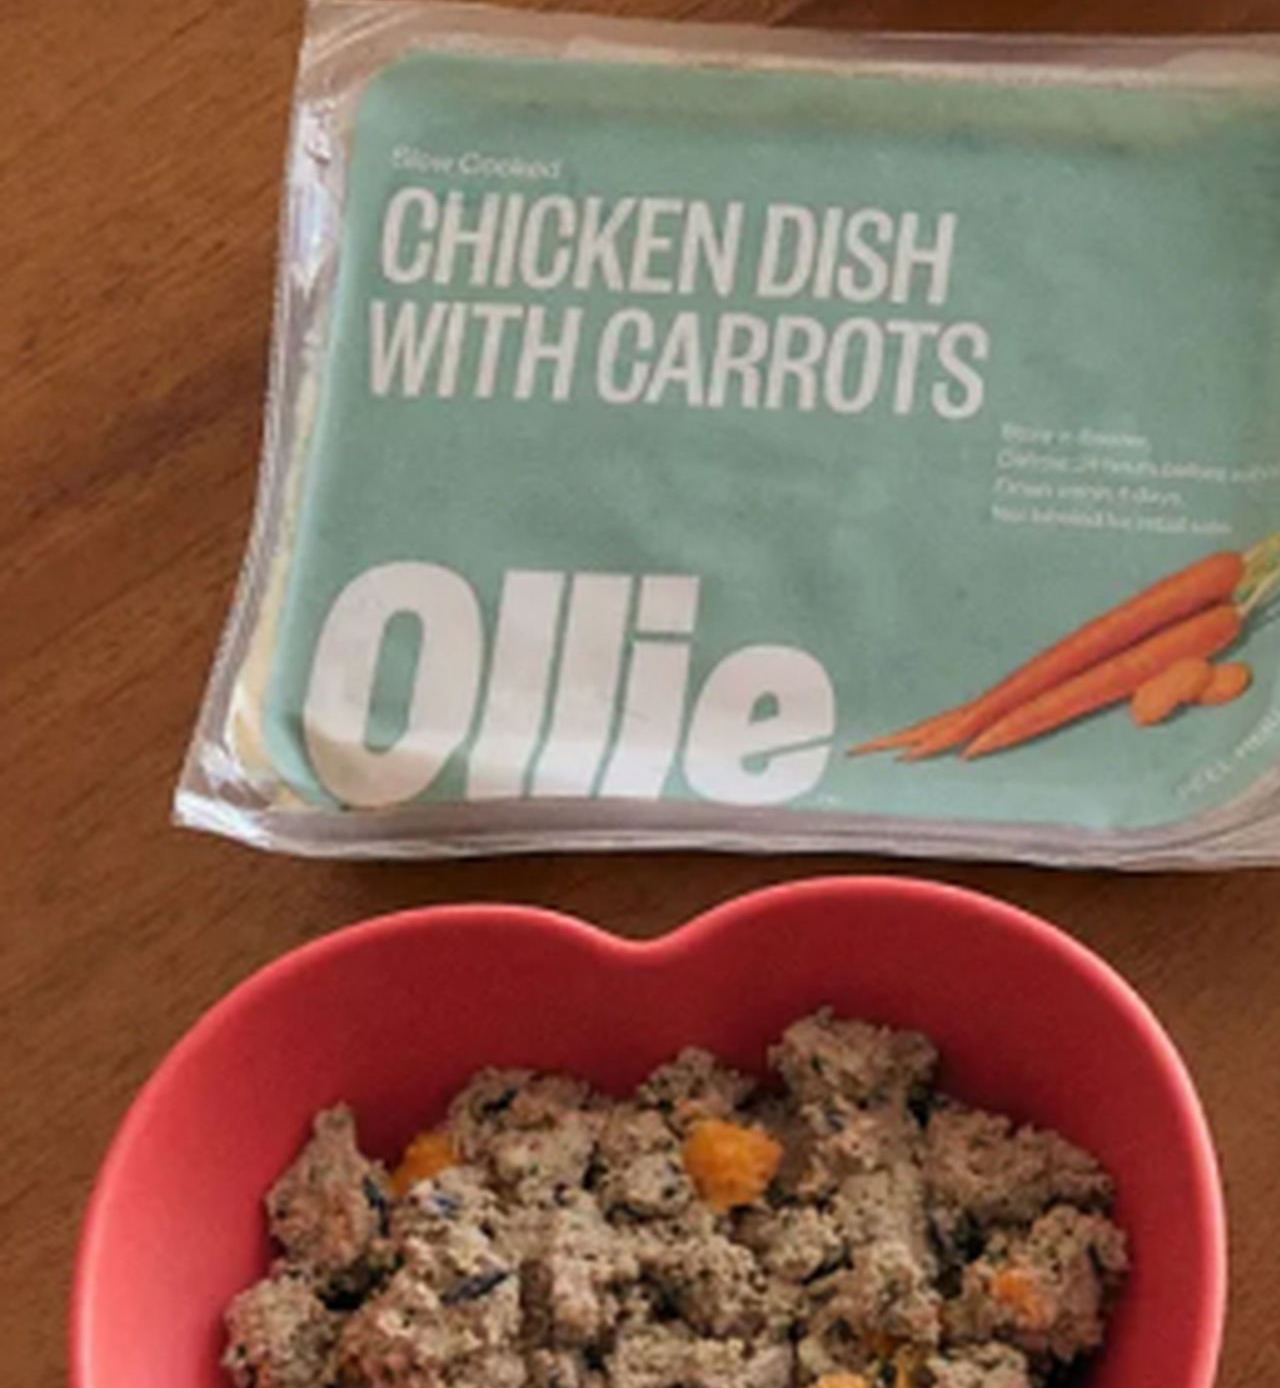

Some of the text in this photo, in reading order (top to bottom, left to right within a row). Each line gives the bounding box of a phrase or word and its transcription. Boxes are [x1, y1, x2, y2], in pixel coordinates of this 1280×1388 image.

[381, 187, 957, 305] CHICKEN DISH
[370, 299, 988, 419] WITH CARROTS
[303, 560, 837, 810] Ollie
